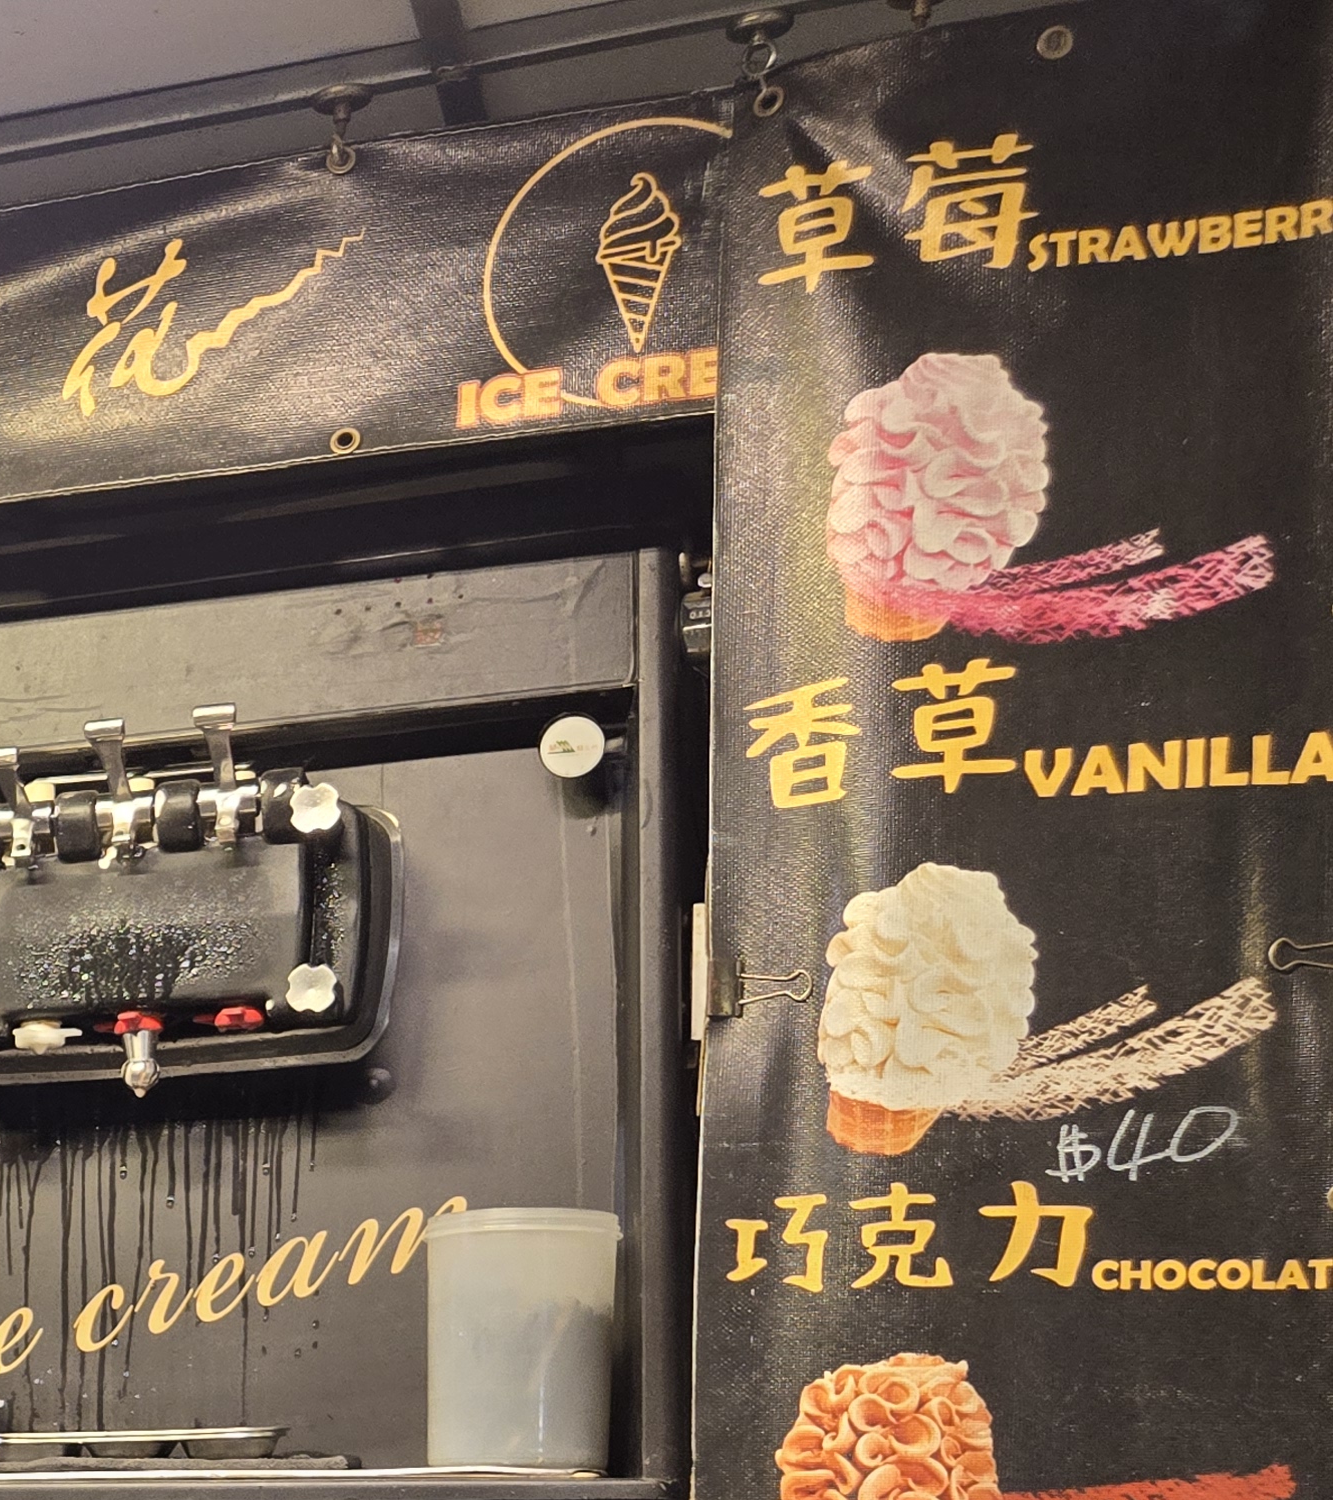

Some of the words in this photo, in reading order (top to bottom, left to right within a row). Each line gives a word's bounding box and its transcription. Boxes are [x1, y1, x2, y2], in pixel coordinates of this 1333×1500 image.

[758, 133, 1039, 294] 草莓
[1028, 198, 1333, 272] STRAWBERR
[456, 367, 564, 430] ICE
[744, 656, 1016, 809] 香草
[1023, 730, 1333, 798] VANILLA
[1046, 1105, 1239, 1183] $40
[725, 1180, 1095, 1293] 巧克力
[1091, 1257, 1333, 1292] CHOCOLAT
